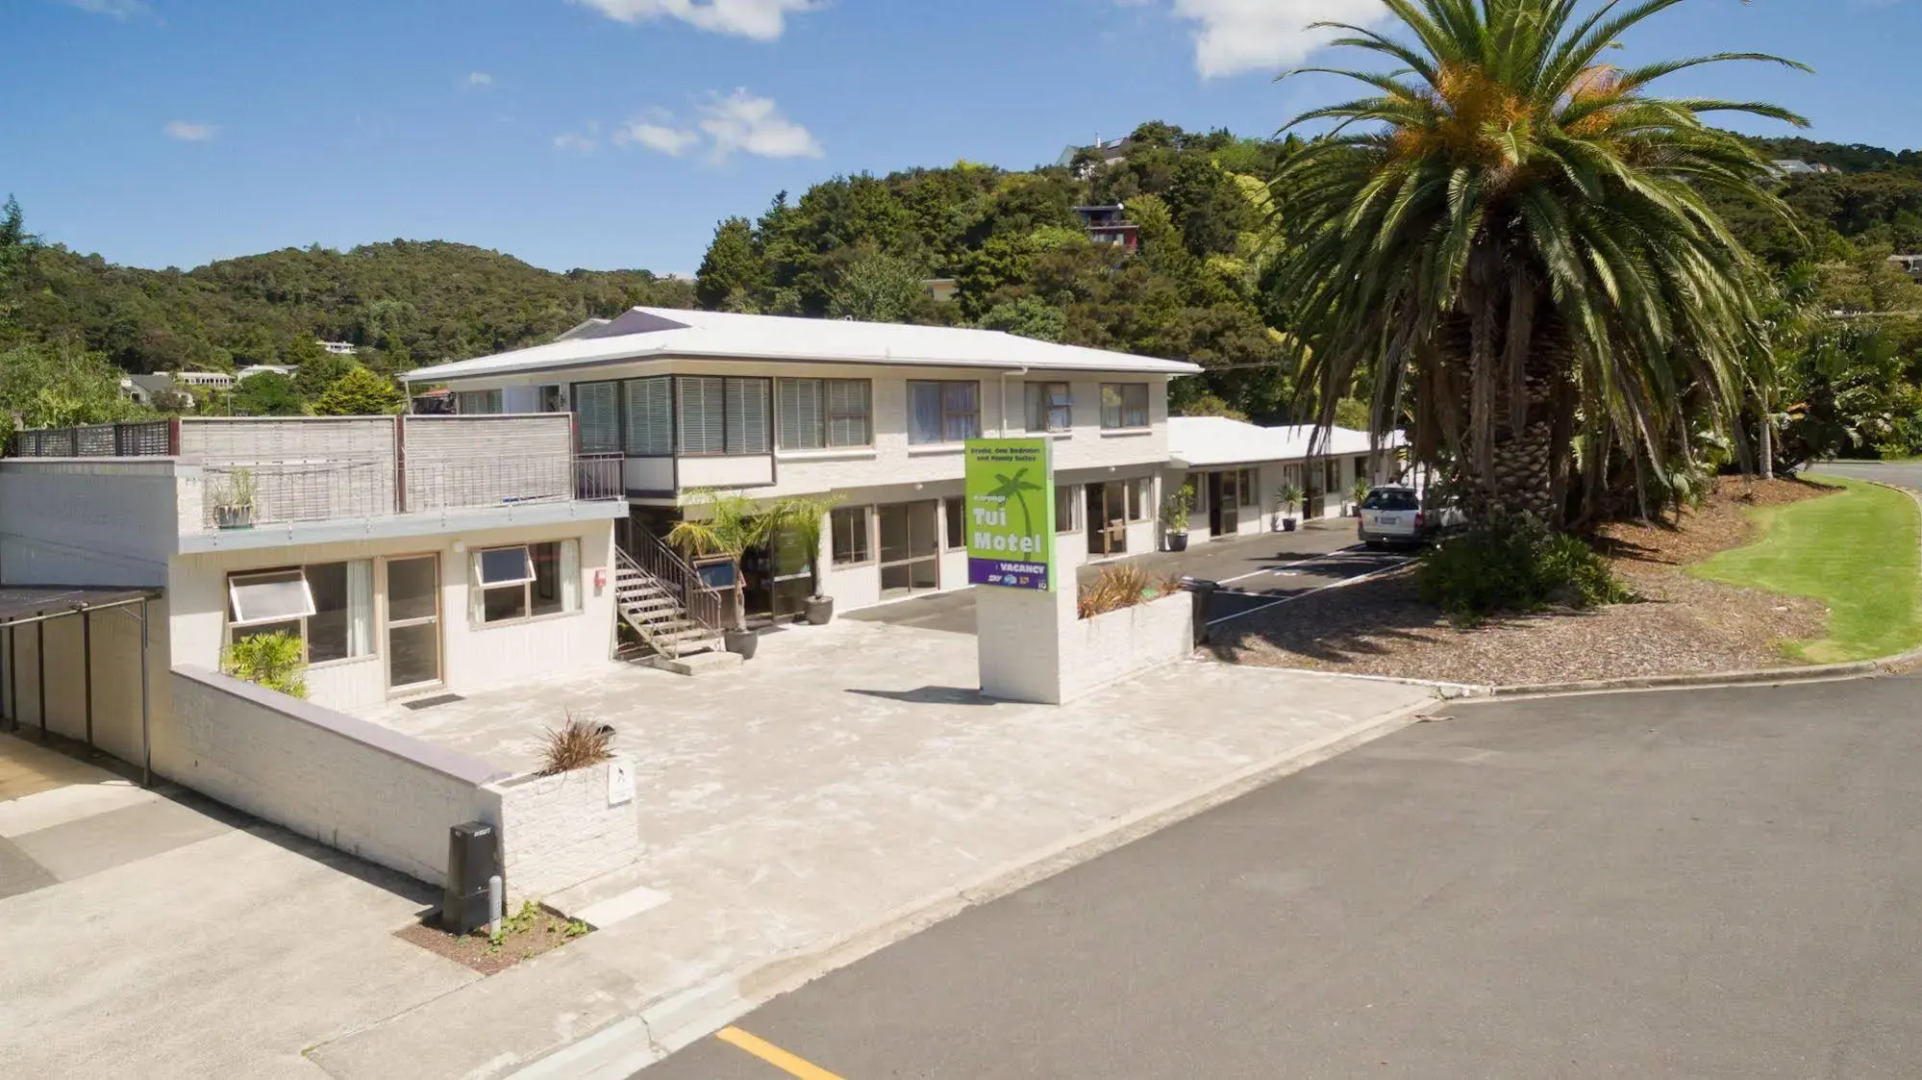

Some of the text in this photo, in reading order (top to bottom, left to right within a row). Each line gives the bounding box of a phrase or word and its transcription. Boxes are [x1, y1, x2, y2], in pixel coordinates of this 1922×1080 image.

[973, 507, 1007, 526] Tui
[974, 532, 1042, 554] Motel
[1000, 563, 1045, 574] VACANCY
